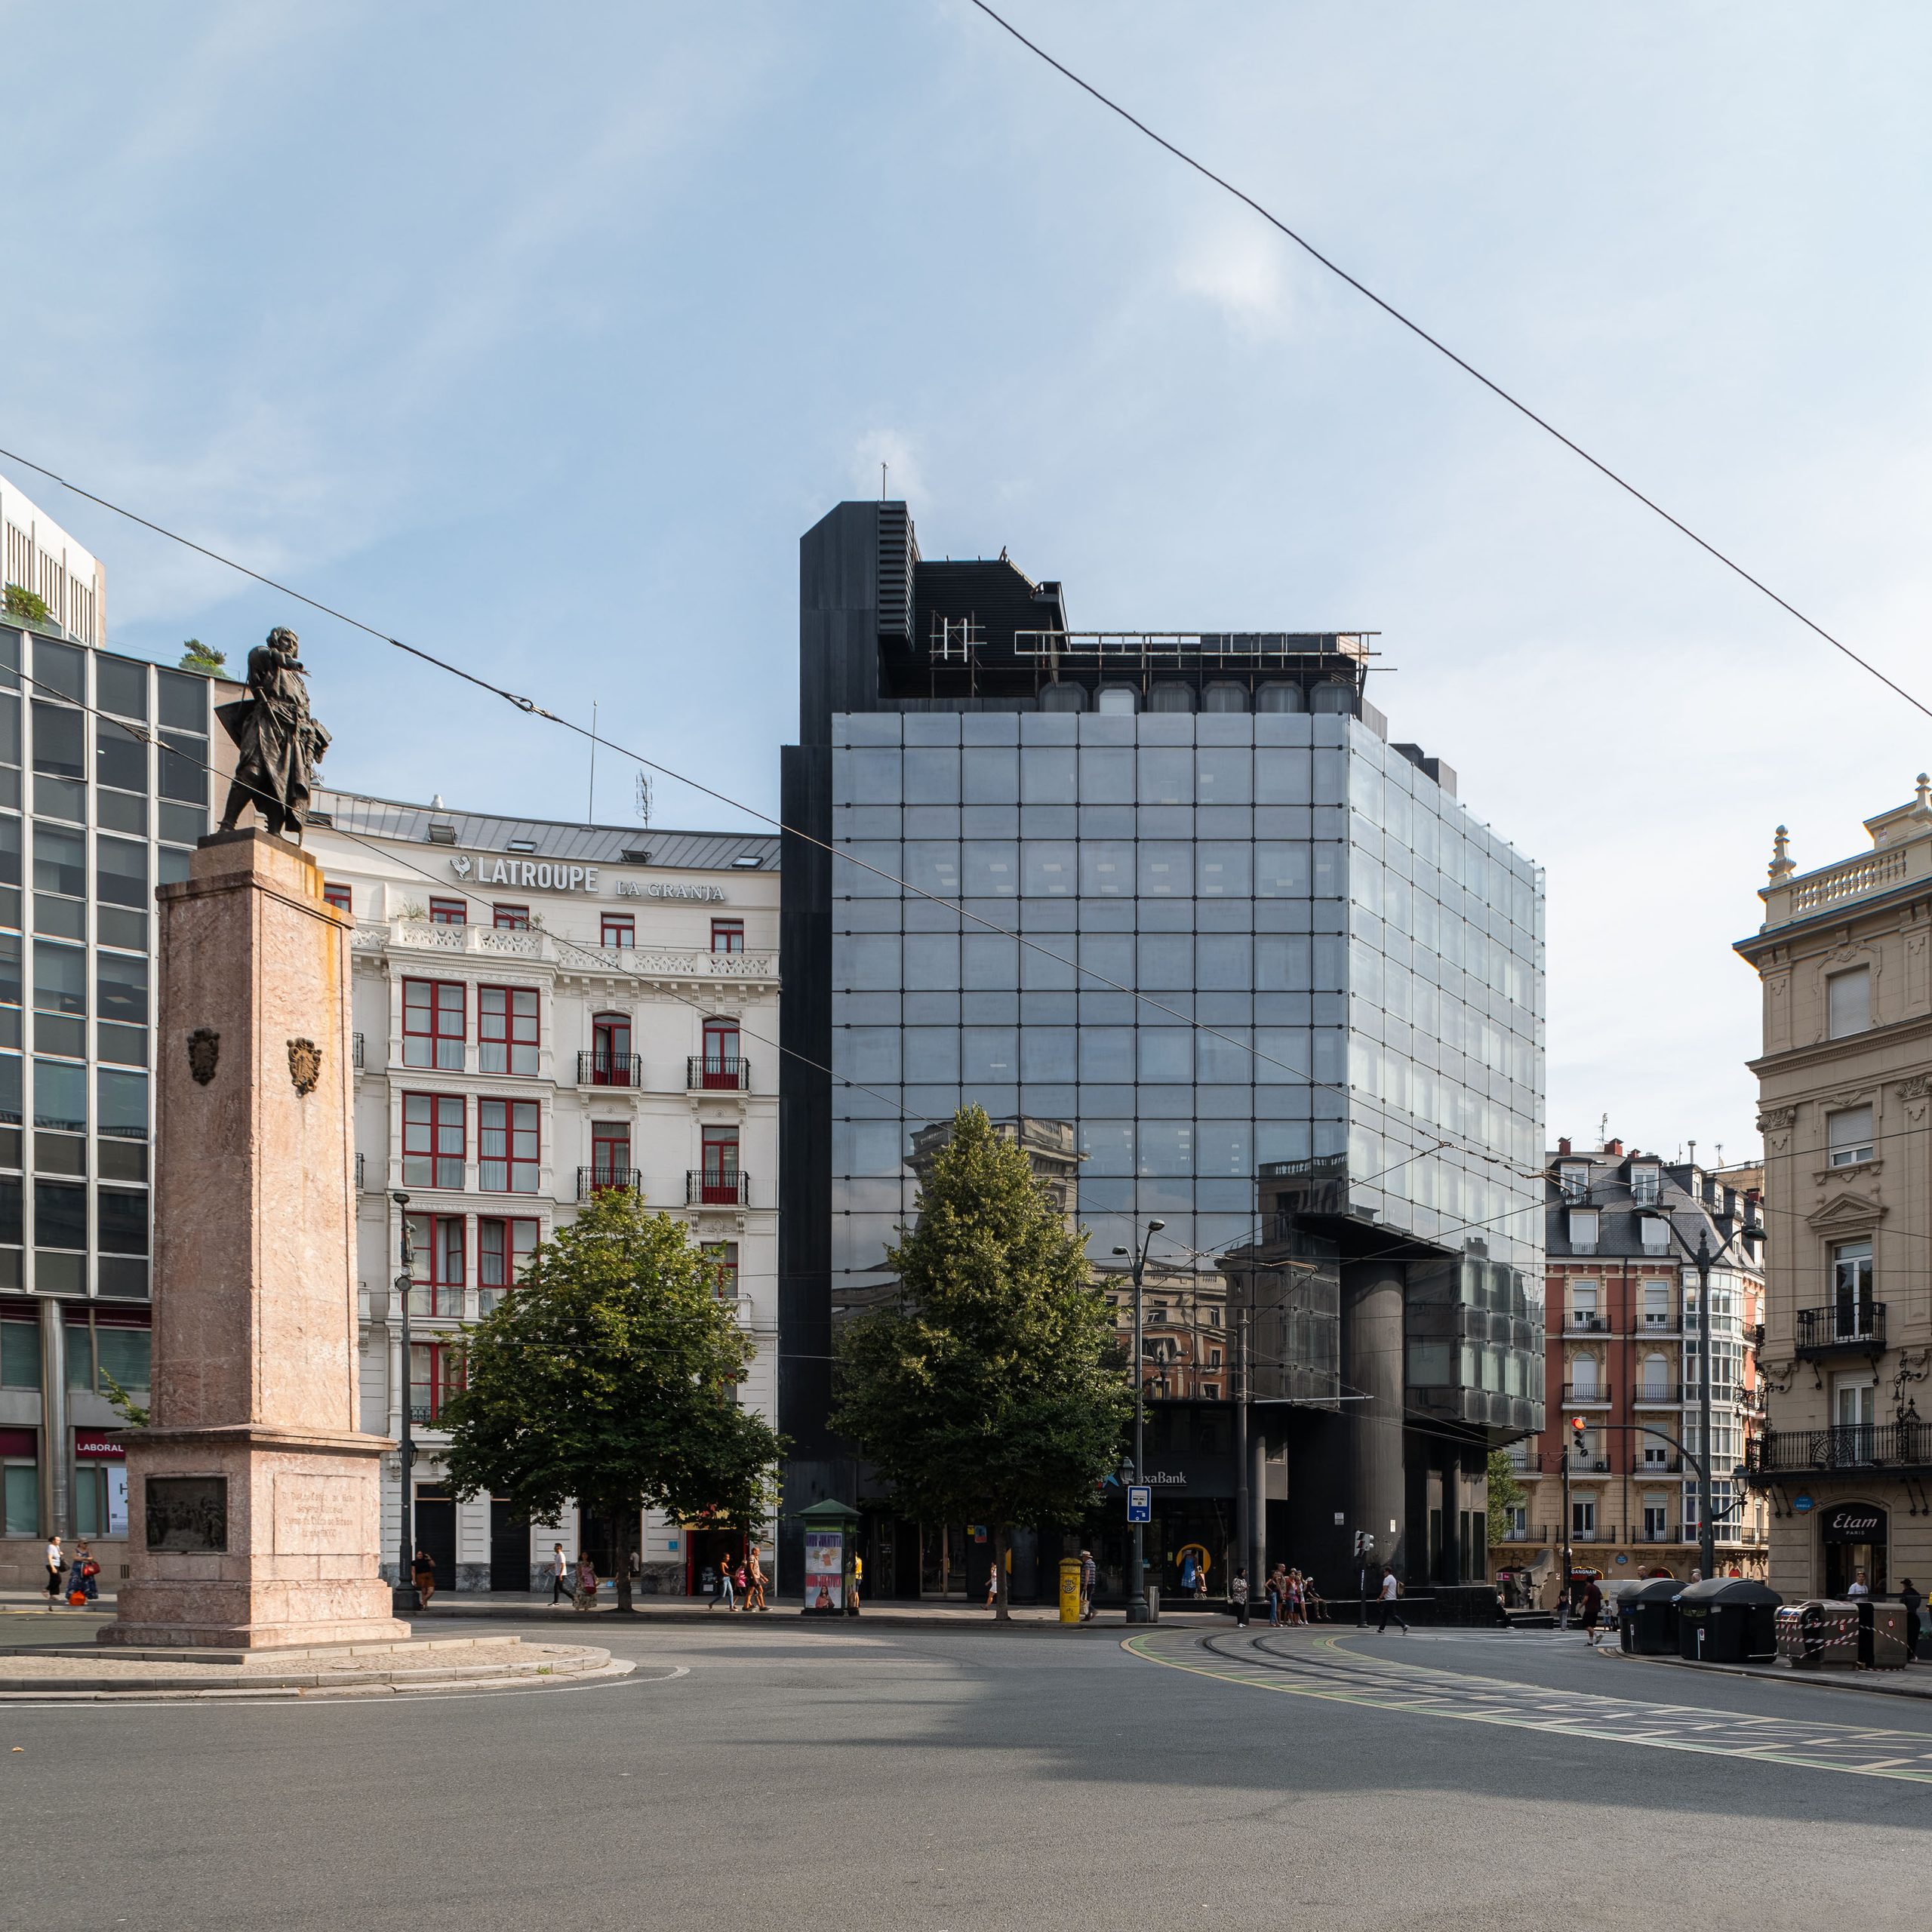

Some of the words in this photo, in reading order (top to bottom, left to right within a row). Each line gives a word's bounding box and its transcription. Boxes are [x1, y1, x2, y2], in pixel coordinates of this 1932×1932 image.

[478, 857, 599, 893] LATROUPE
[616, 881, 640, 896] LA
[648, 883, 725, 902] GRANJA
[77, 1443, 124, 1452] LABORAL
[1140, 1471, 1187, 1484] ixaBank
[1832, 1513, 1878, 1528] Etam
